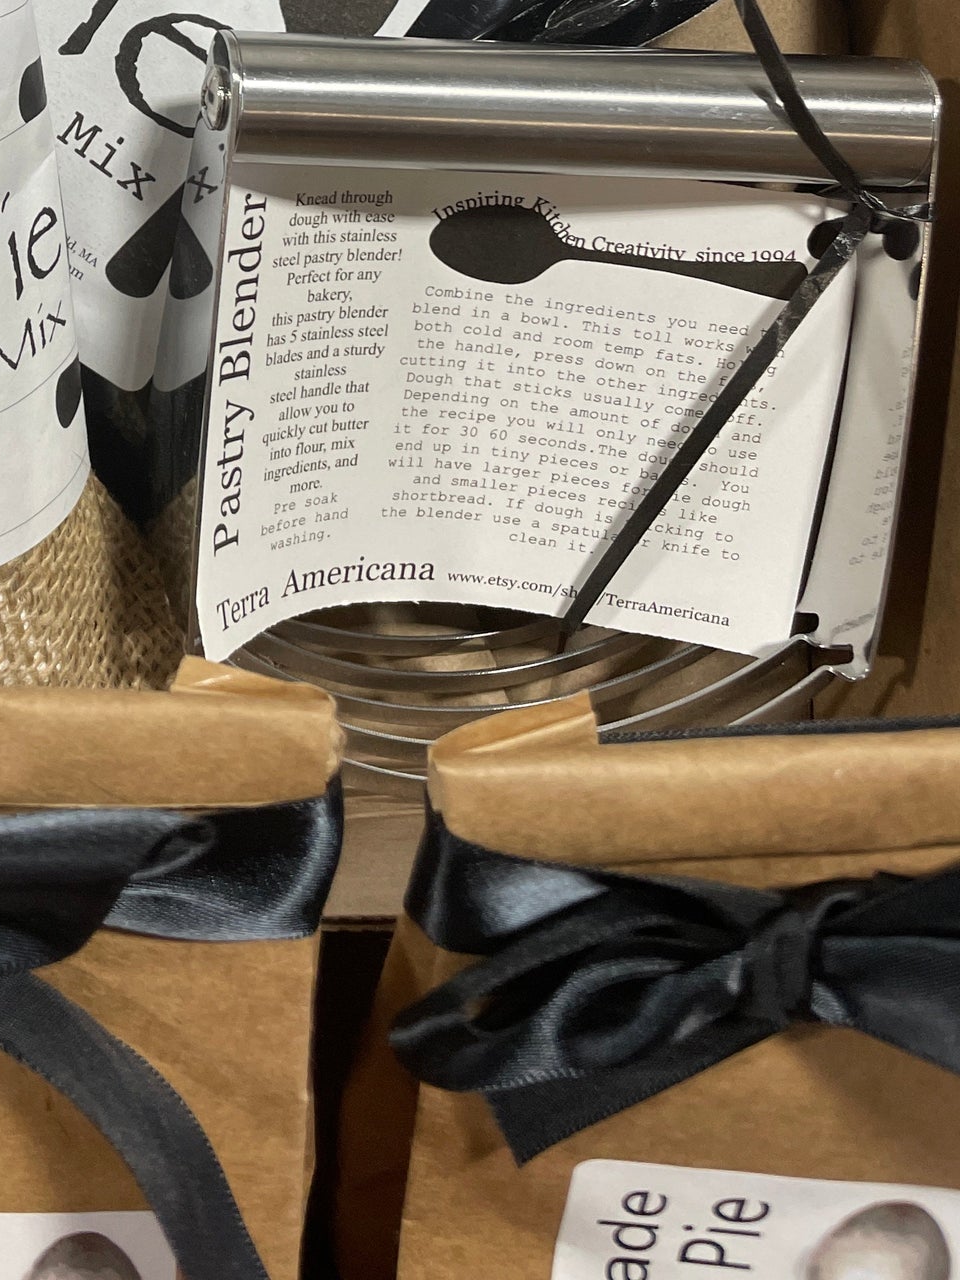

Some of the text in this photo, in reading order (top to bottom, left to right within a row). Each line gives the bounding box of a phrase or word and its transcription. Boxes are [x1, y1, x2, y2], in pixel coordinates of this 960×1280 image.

[57, 111, 156, 202] Mix
[296, 190, 393, 206] Knead through
[289, 212, 395, 229] dough with ease
[431, 190, 797, 263] Inspiring Kitchen Creativity since 1994
[282, 229, 397, 247] with this stainless
[272, 248, 402, 268] steel pastry blender!
[286, 268, 382, 286] Perfect for any
[307, 289, 353, 304] bakery,
[271, 305, 389, 328] this pastry blender
[425, 285, 750, 337] Combine the ingredients you need
[267, 324, 389, 347] has 5 stainless steel
[412, 303, 461, 316] blend
[471, 307, 490, 319] in
[501, 312, 510, 322] a
[521, 312, 569, 329] bowl.
[583, 321, 622, 337] This
[633, 329, 673, 344] toll
[684, 337, 735, 353] works
[265, 347, 303, 367] blades
[306, 346, 329, 360] and
[332, 347, 340, 357] a
[344, 343, 386, 359] sturdy
[414, 321, 704, 366] both cold and room temp fats.
[213, 193, 268, 557] Pastry Blender
[294, 364, 347, 381] stainless
[270, 381, 369, 404] steel handle that
[278, 402, 355, 422] allow you to
[262, 418, 369, 446] quickly cut butter
[270, 438, 356, 461] into flour, mix
[263, 454, 359, 482] ingredients, and
[290, 479, 323, 494] more.
[273, 492, 338, 515] Pre soak
[260, 508, 349, 536] before hand
[270, 532, 331, 551] washing.
[509, 532, 595, 555] clean it.
[216, 585, 270, 632] Terra
[281, 555, 435, 598] Americana
[679, 1197, 770, 1270] Pie
